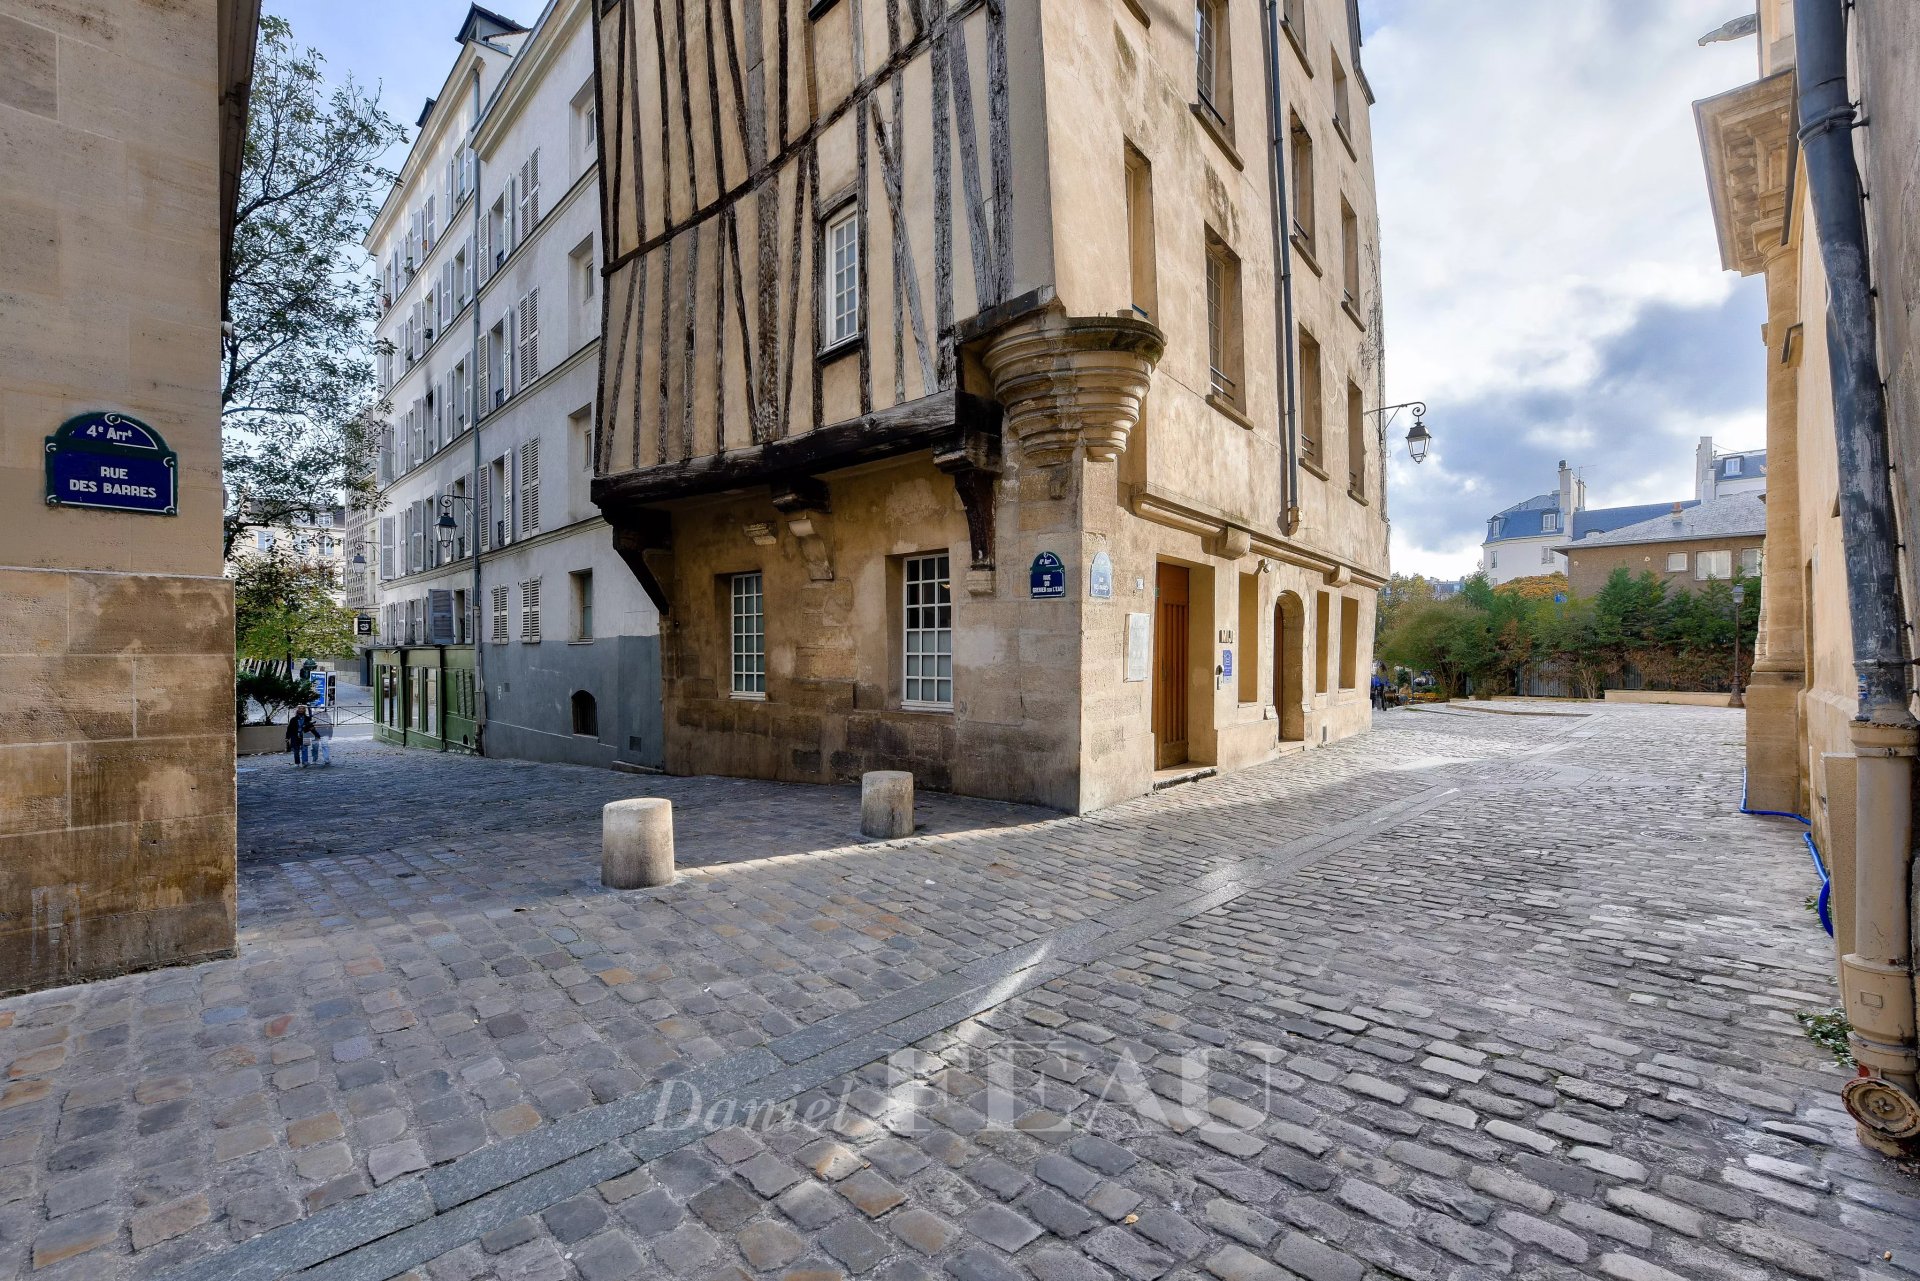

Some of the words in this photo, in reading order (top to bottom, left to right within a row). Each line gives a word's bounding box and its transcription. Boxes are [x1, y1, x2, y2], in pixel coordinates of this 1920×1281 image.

[86, 424, 104, 437] 4e
[106, 427, 133, 441] Arrt
[100, 466, 129, 480] RUE
[69, 479, 98, 493] DES
[102, 482, 157, 498] BARRES
